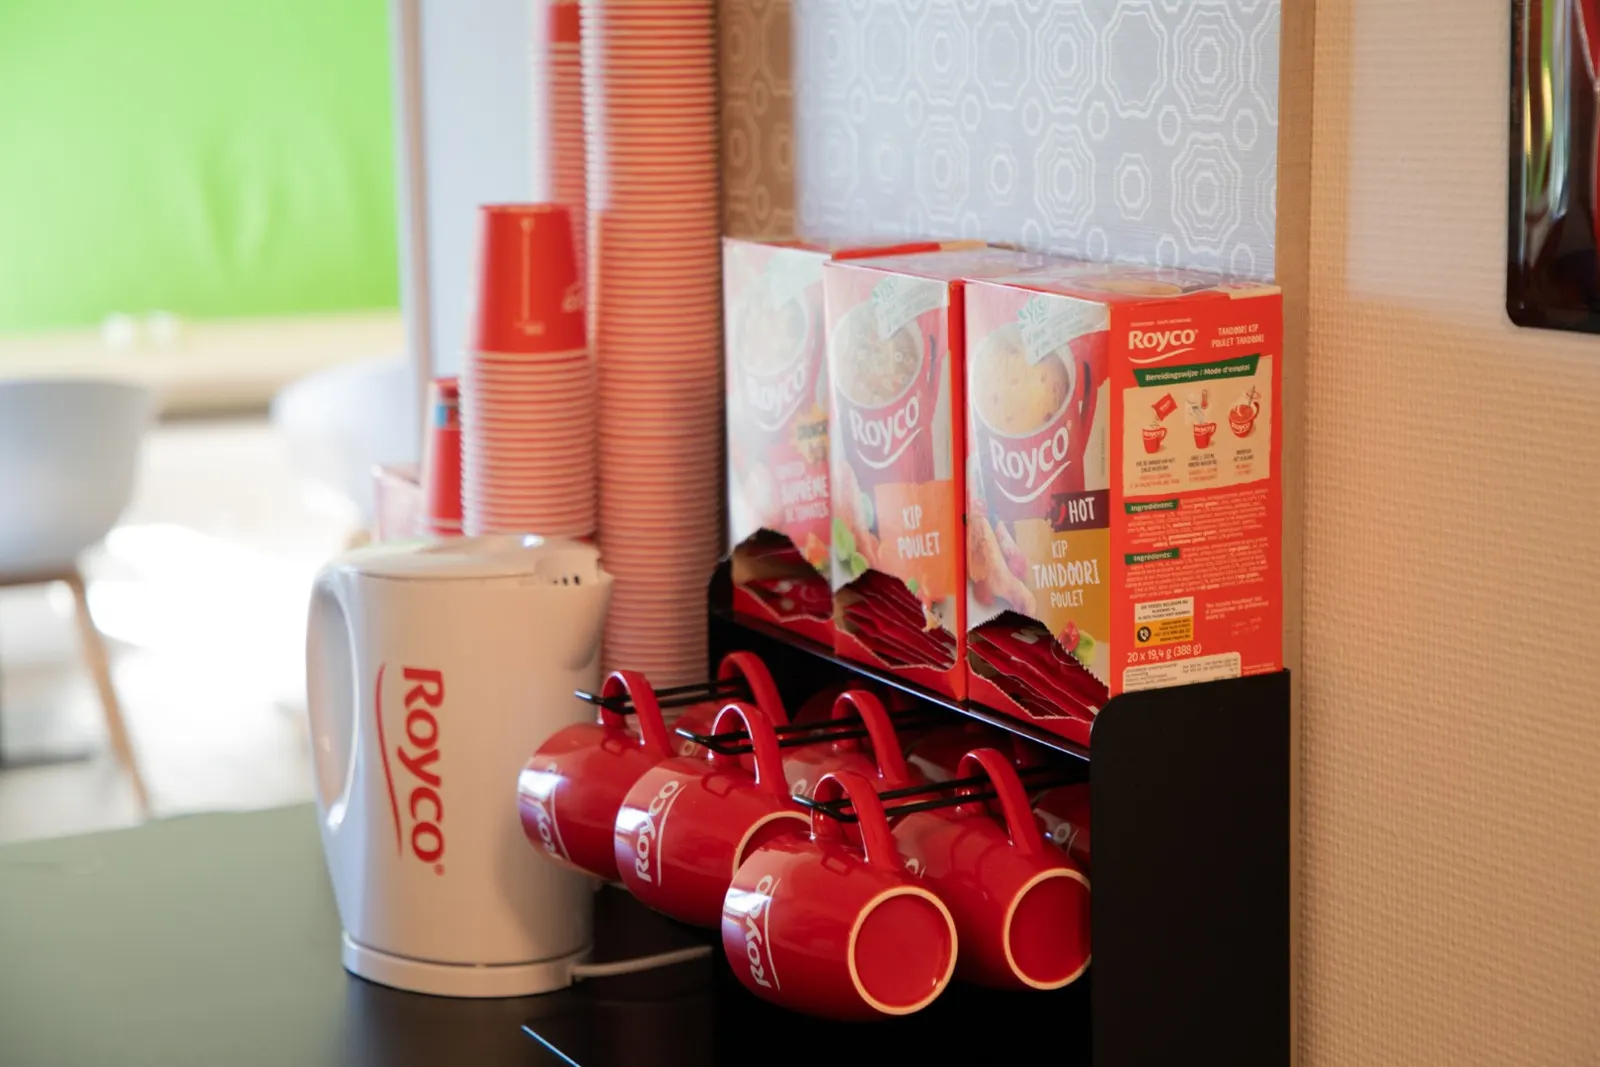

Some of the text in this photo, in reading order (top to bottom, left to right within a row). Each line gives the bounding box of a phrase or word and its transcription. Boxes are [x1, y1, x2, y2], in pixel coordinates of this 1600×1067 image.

[1129, 329, 1196, 352] Royco
[1211, 338, 1234, 347] POULET
[1204, 366, 1221, 376] Mode
[849, 396, 920, 456] Royco
[988, 426, 1070, 489] Royco
[902, 505, 923, 529] KIP
[1068, 497, 1096, 524] HOT
[897, 532, 940, 559] POULET
[1052, 540, 1068, 559] KIP
[1032, 559, 1101, 589] TANDOORI
[1050, 589, 1084, 608] POULET
[1127, 643, 1202, 663] 20 x 19,4 g (388 g)
[397, 667, 445, 863] Royco
[635, 780, 679, 883] Royco
[745, 874, 772, 988] Royco
